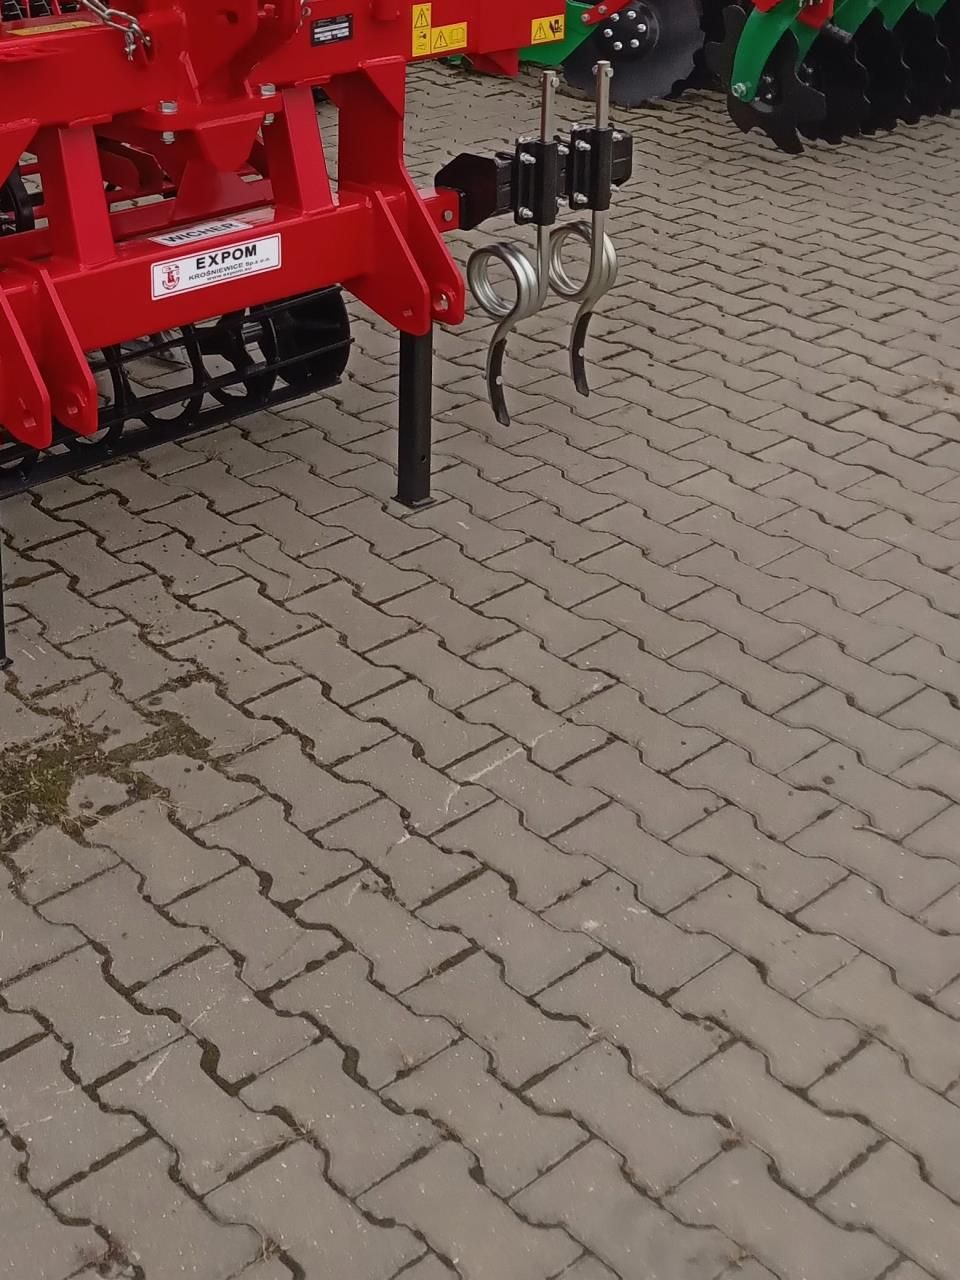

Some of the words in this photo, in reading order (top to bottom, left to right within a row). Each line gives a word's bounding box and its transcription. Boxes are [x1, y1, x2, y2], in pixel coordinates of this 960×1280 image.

[162, 222, 238, 242] WICHER
[196, 244, 257, 270] EXPOM
[188, 263, 244, 281] KROŚNIEWICE
